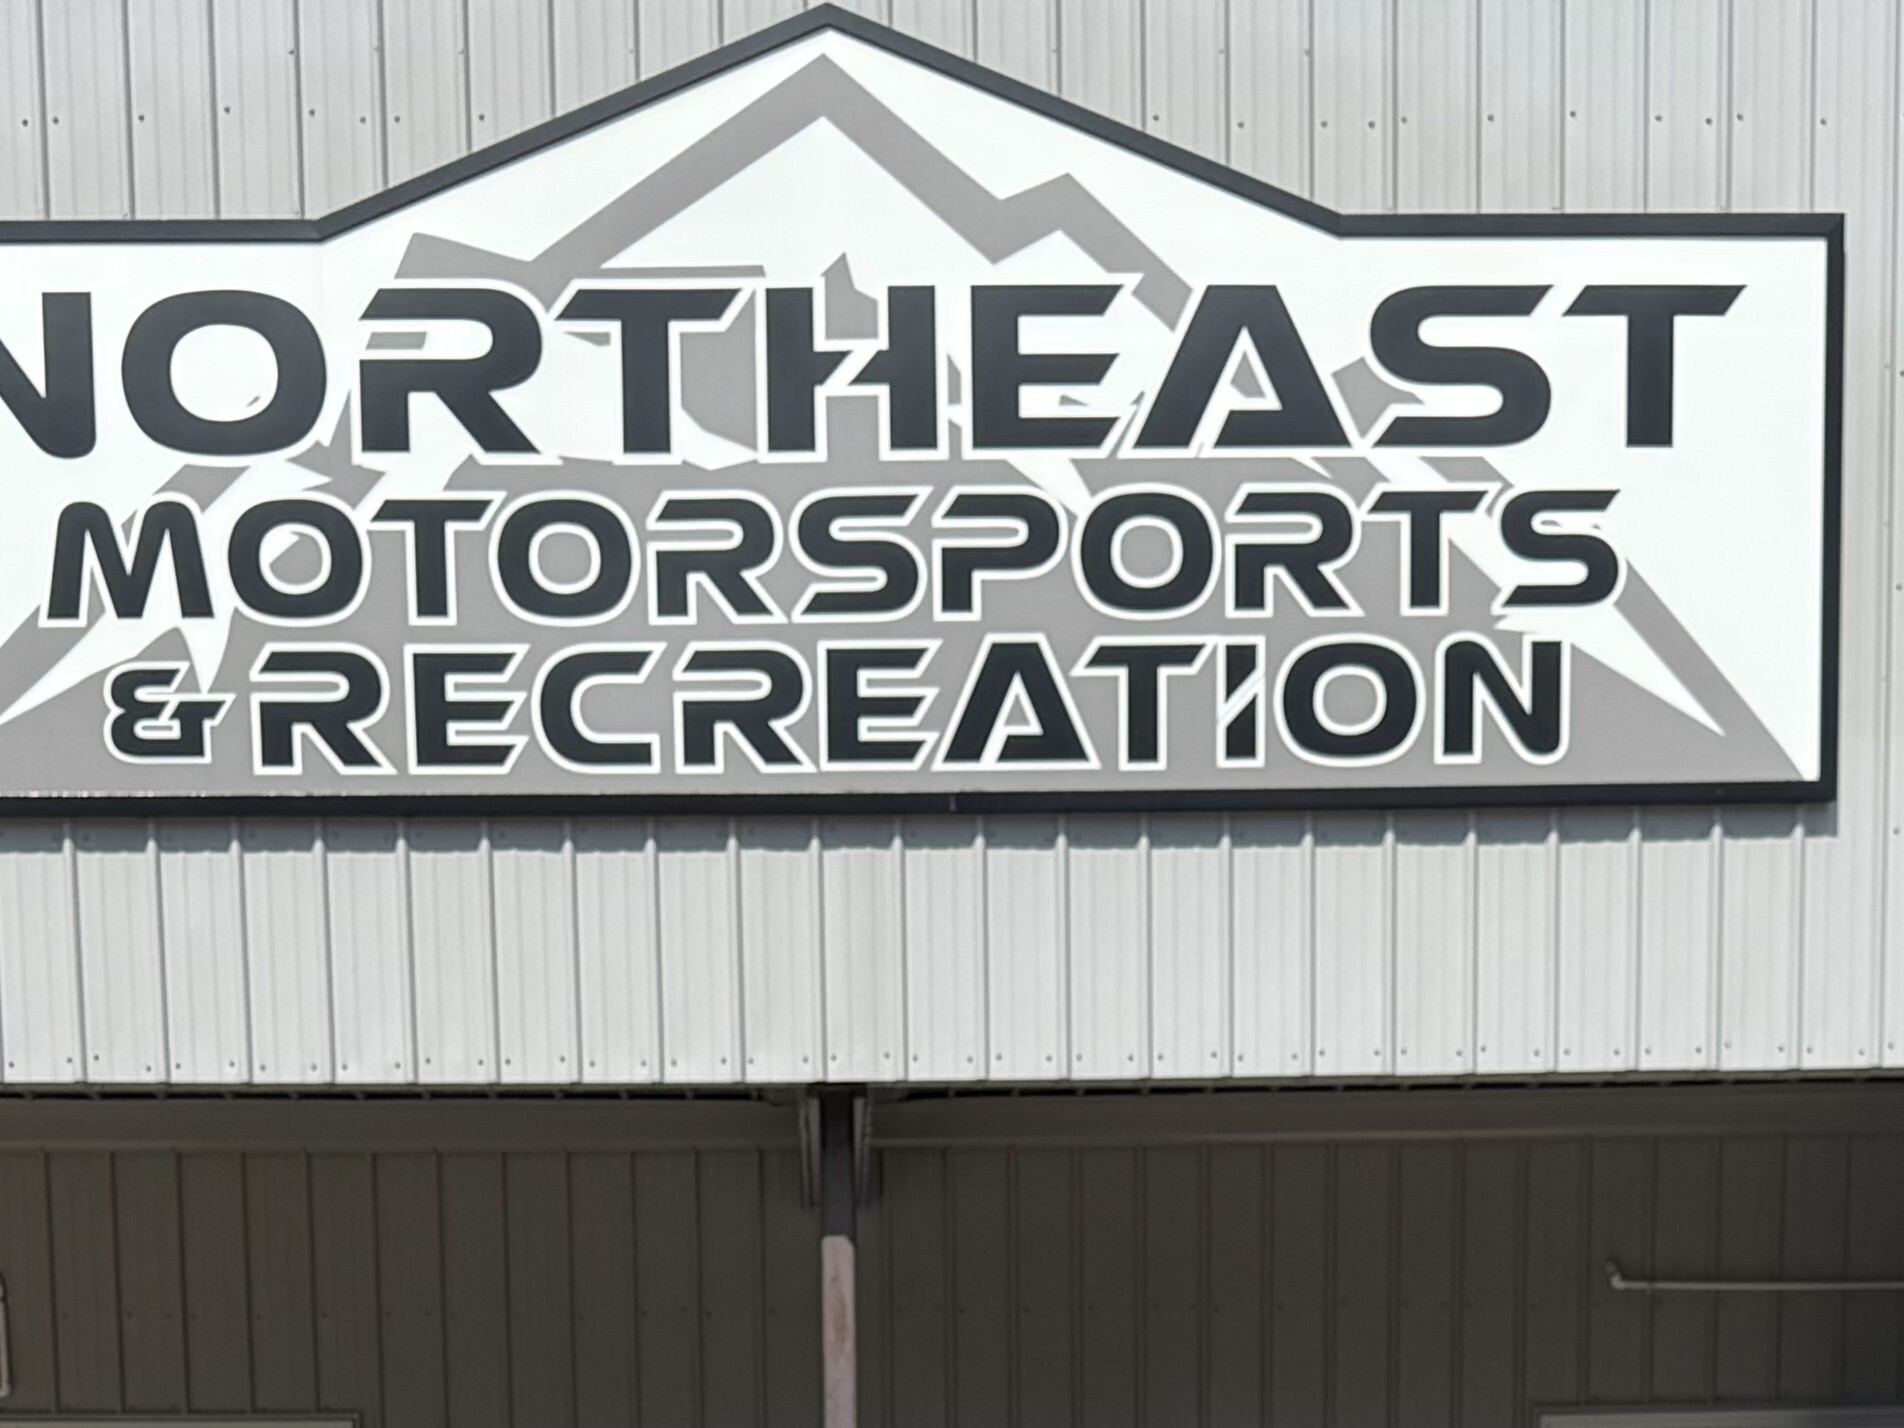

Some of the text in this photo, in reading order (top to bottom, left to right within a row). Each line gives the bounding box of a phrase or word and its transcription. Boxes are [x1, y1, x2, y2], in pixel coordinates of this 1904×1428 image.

[47, 490, 1619, 620] MOTORSPORTS
[109, 640, 1561, 767] & RECREATION
